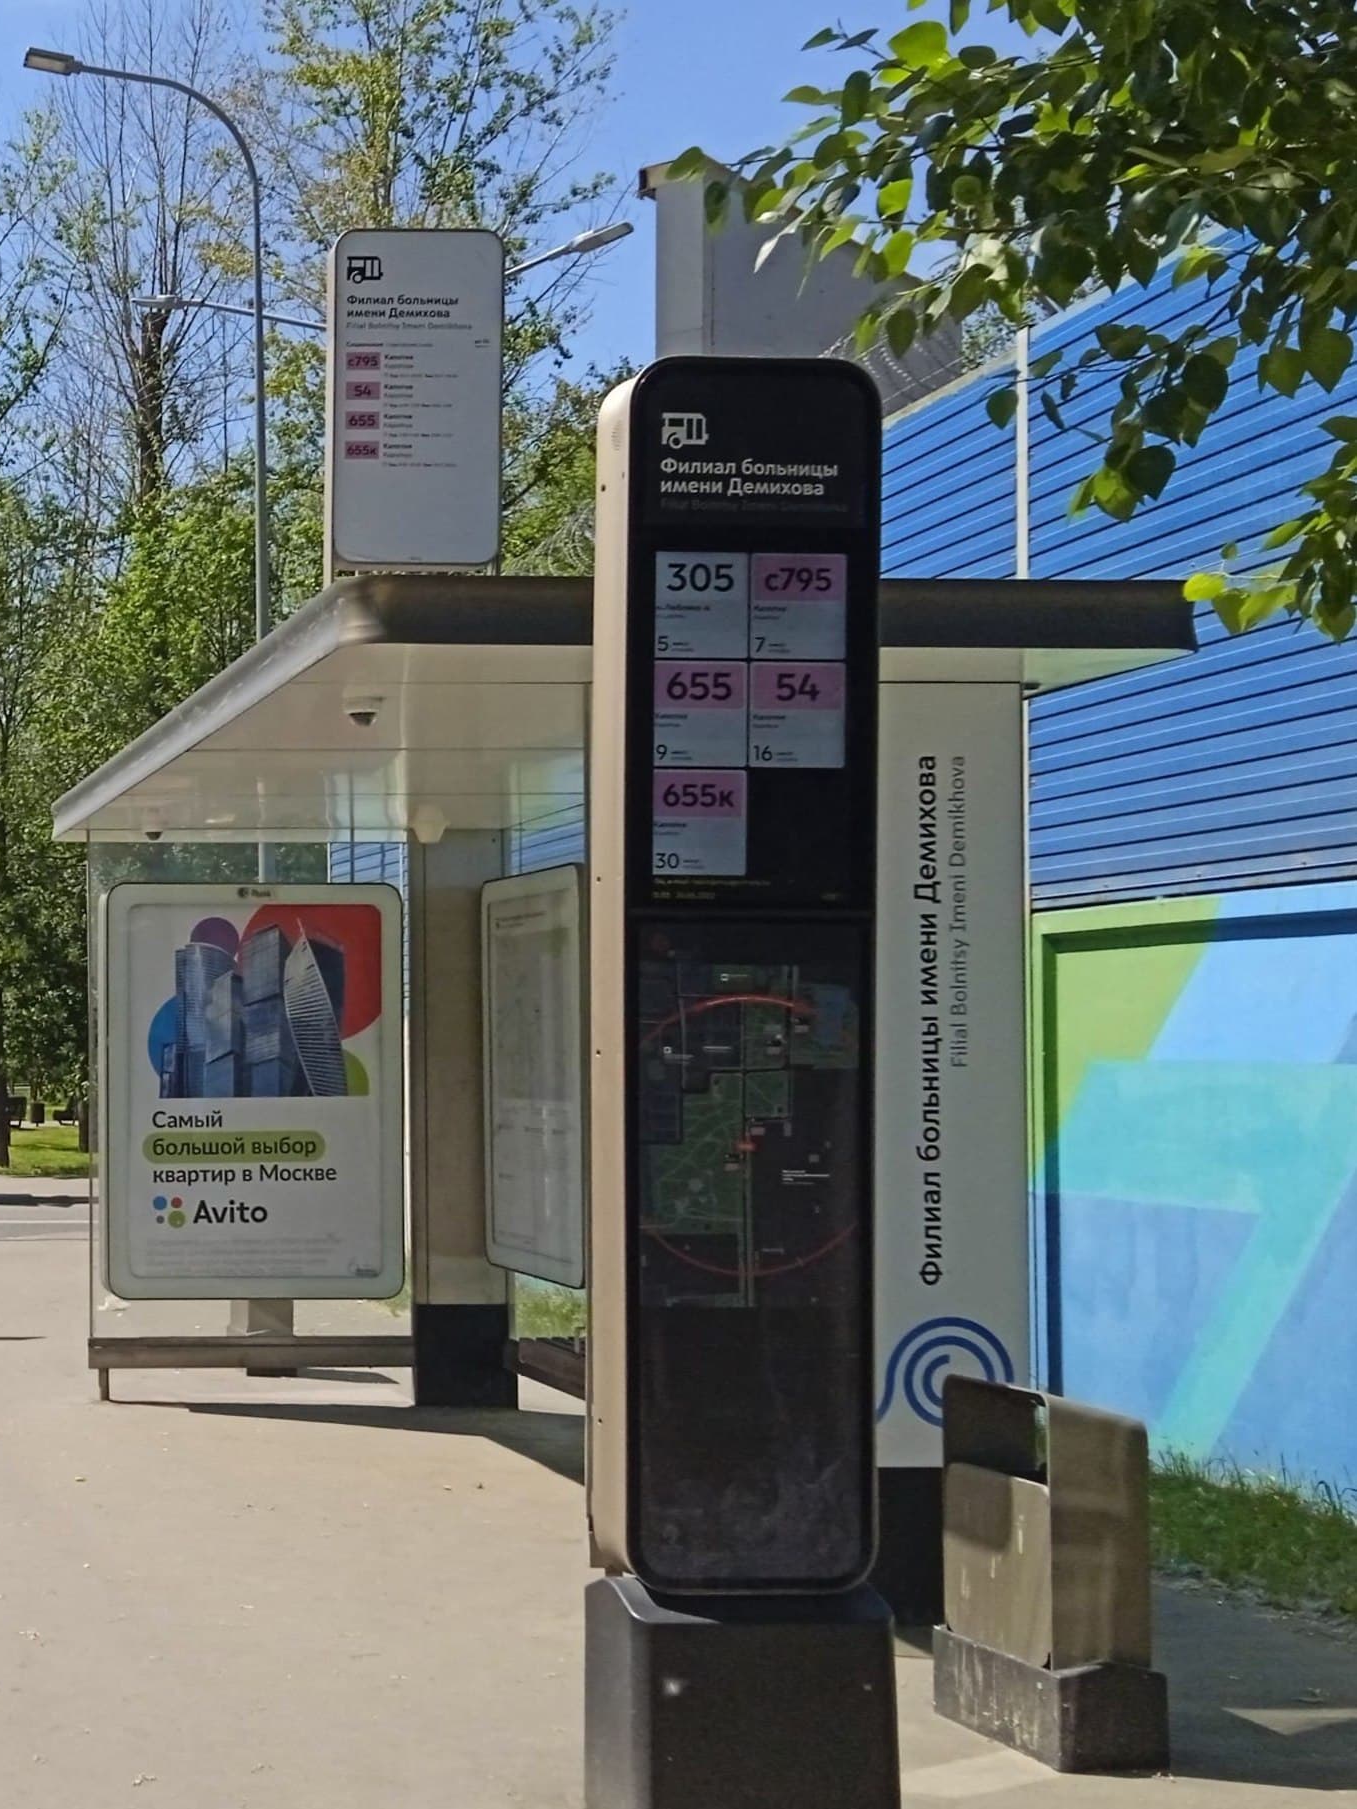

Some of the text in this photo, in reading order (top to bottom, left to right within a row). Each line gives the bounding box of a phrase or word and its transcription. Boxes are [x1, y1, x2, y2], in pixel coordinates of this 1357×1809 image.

[347, 294, 459, 306] Филиал больницы
[347, 308, 451, 319] имени Демихова
[354, 385, 372, 397] 54
[348, 414, 376, 427] 655
[660, 457, 839, 479] Филиал больницы
[660, 477, 825, 497] имени Демихова
[666, 563, 735, 592] 305
[764, 567, 833, 592] с795
[657, 635, 669, 651] 5
[754, 636, 766, 653] 7
[666, 672, 733, 701] 655
[776, 672, 820, 702] 54
[656, 744, 668, 760] 9
[753, 745, 773, 761] 16
[662, 784, 734, 807] 655к
[655, 853, 680, 869] 30
[948, 755, 970, 1067] Filial Bolnitsy Imeni Demikhova
[914, 755, 943, 1286] Филиал больницы имени Демихова
[152, 1110, 223, 1128] Самый
[153, 1137, 317, 1157] большой выбор
[153, 1164, 337, 1186] квартир в Москве
[193, 1199, 268, 1224] Avito
